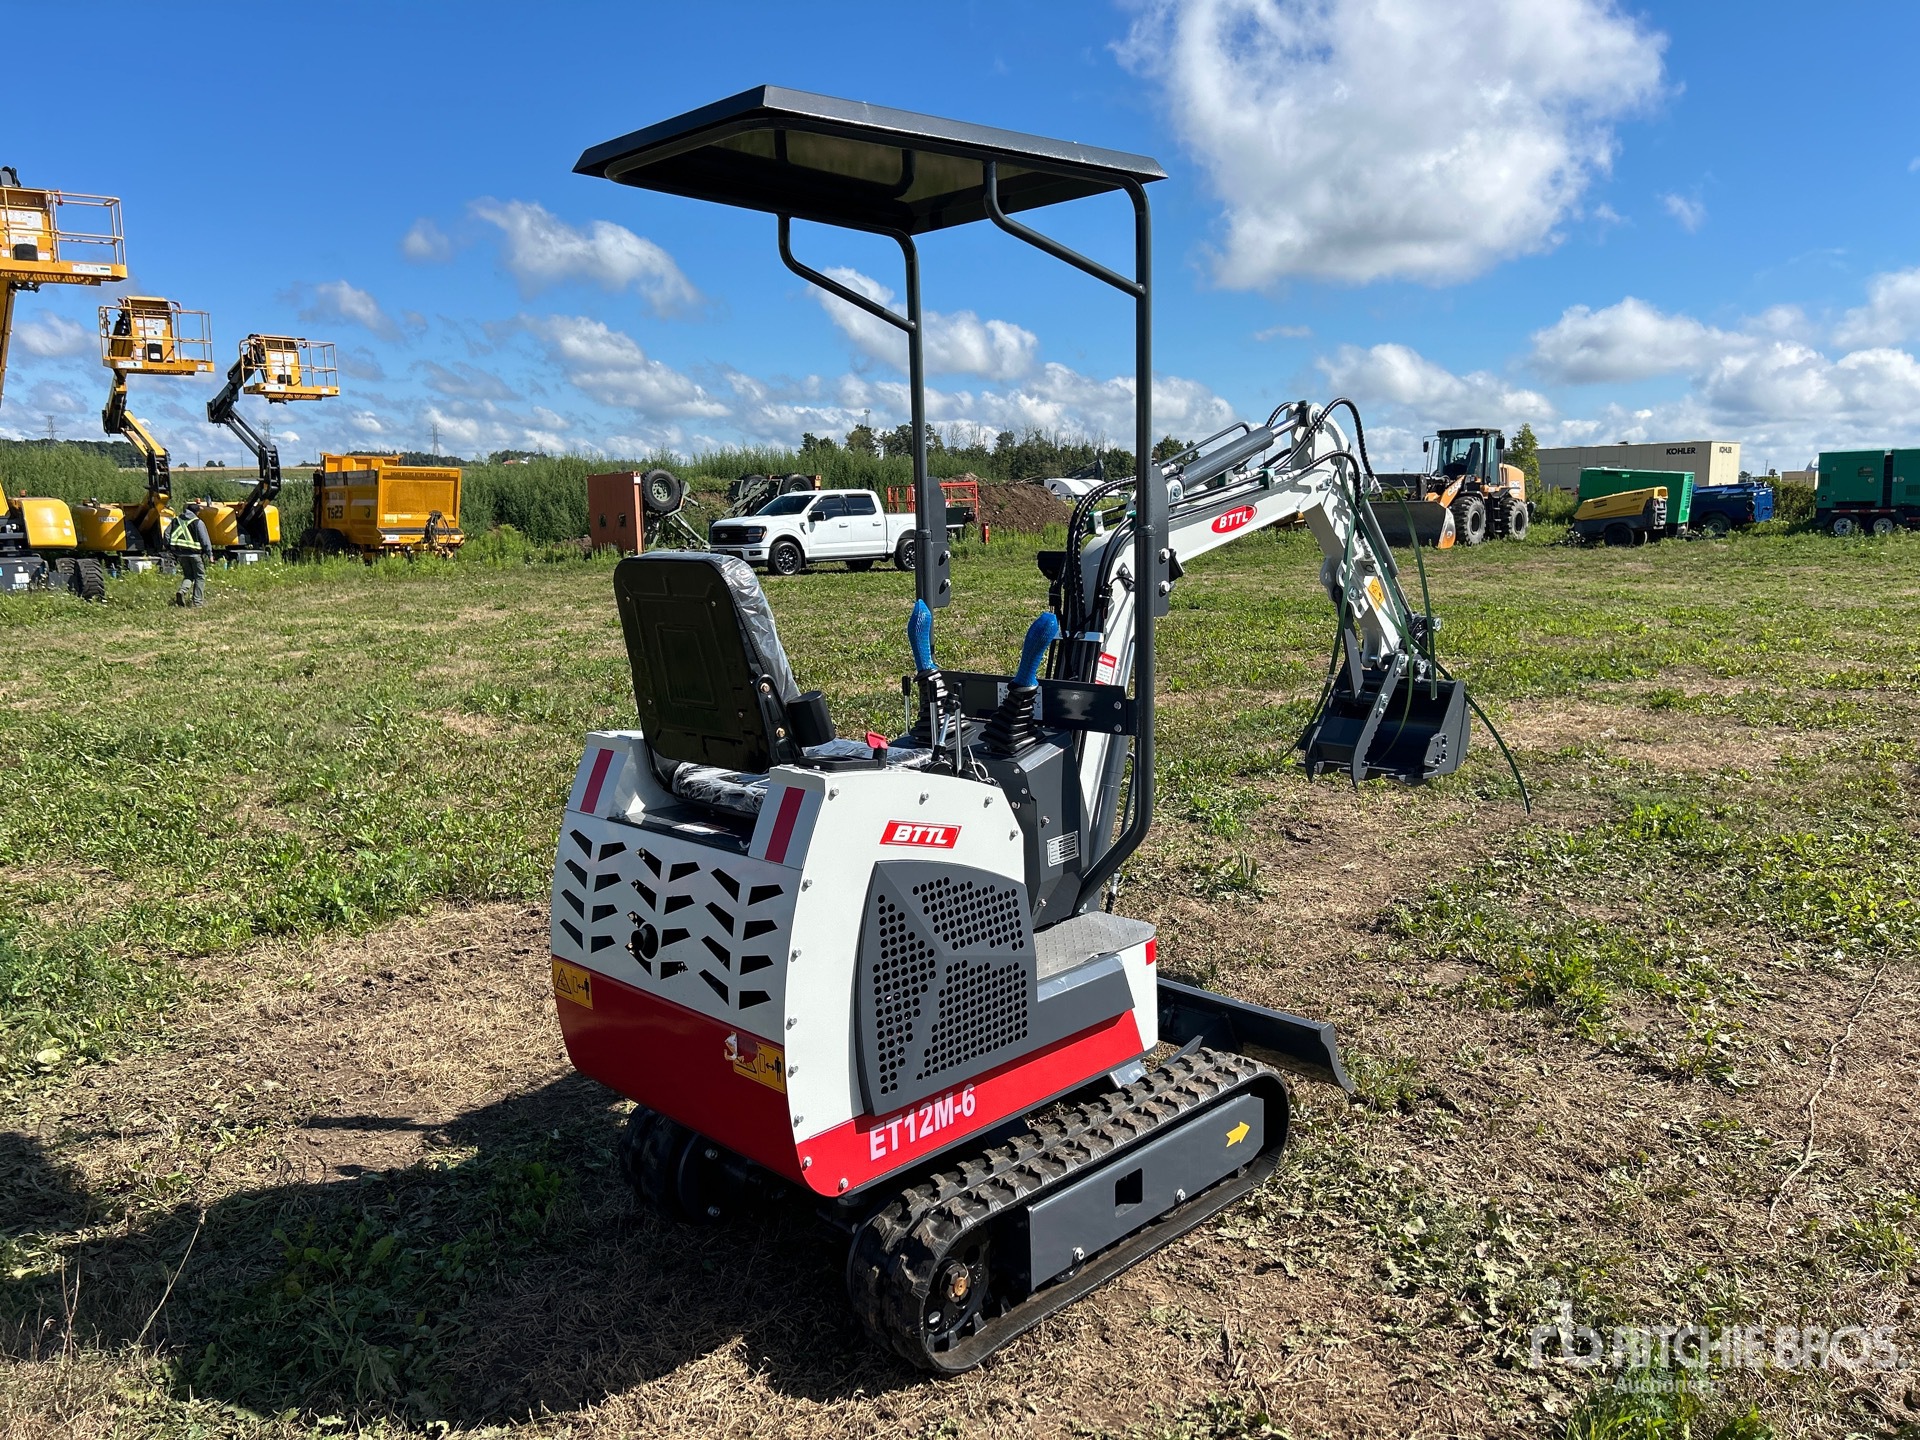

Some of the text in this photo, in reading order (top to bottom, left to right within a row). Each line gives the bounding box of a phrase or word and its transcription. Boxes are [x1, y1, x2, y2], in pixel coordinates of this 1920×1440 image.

[1666, 447, 1696, 455] KOHLER
[1719, 446, 1732, 454] KOHLER
[327, 505, 344, 519] TS23
[1219, 511, 1249, 529] BTTL
[892, 824, 948, 845] BTTL
[869, 1083, 976, 1162] ET12M-6
